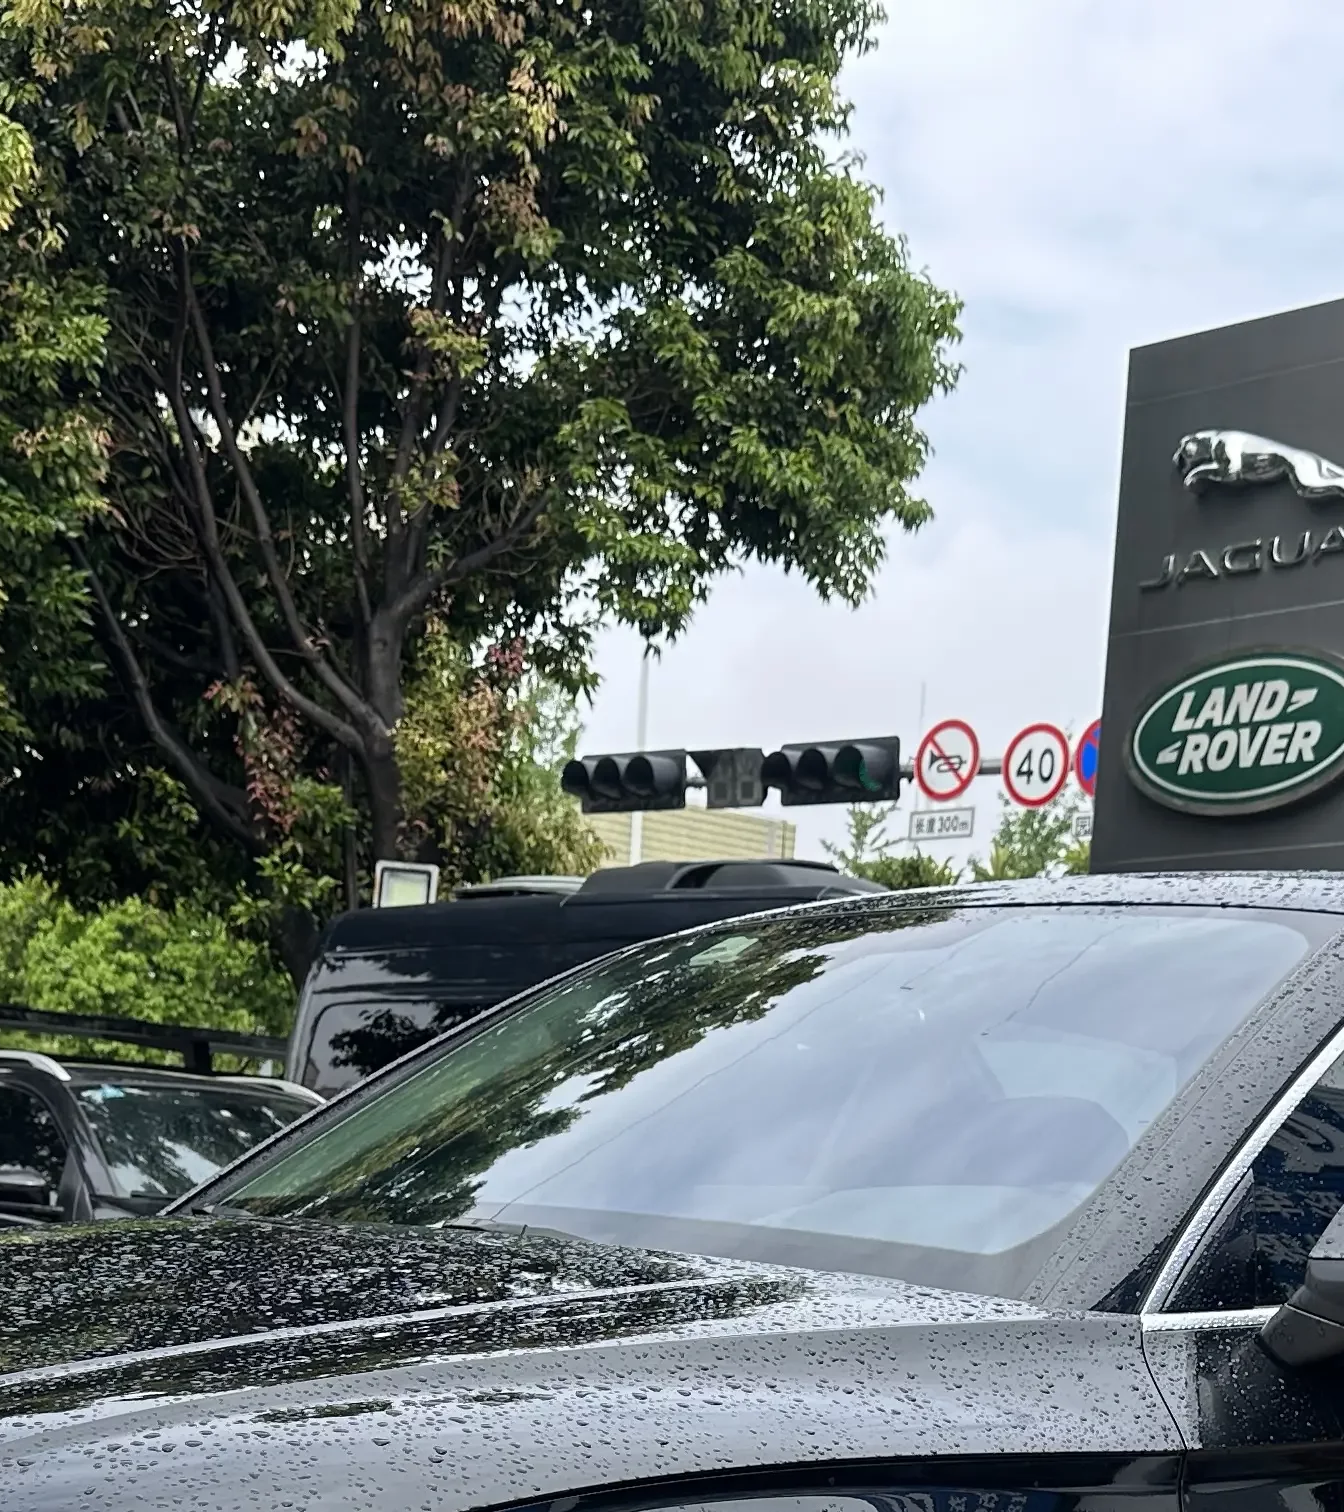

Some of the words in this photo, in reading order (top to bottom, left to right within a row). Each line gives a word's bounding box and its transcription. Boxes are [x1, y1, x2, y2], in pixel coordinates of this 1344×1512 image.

[1171, 679, 1290, 732] LAND
[1015, 749, 1054, 782] 40
[1176, 720, 1322, 776] ROVER
